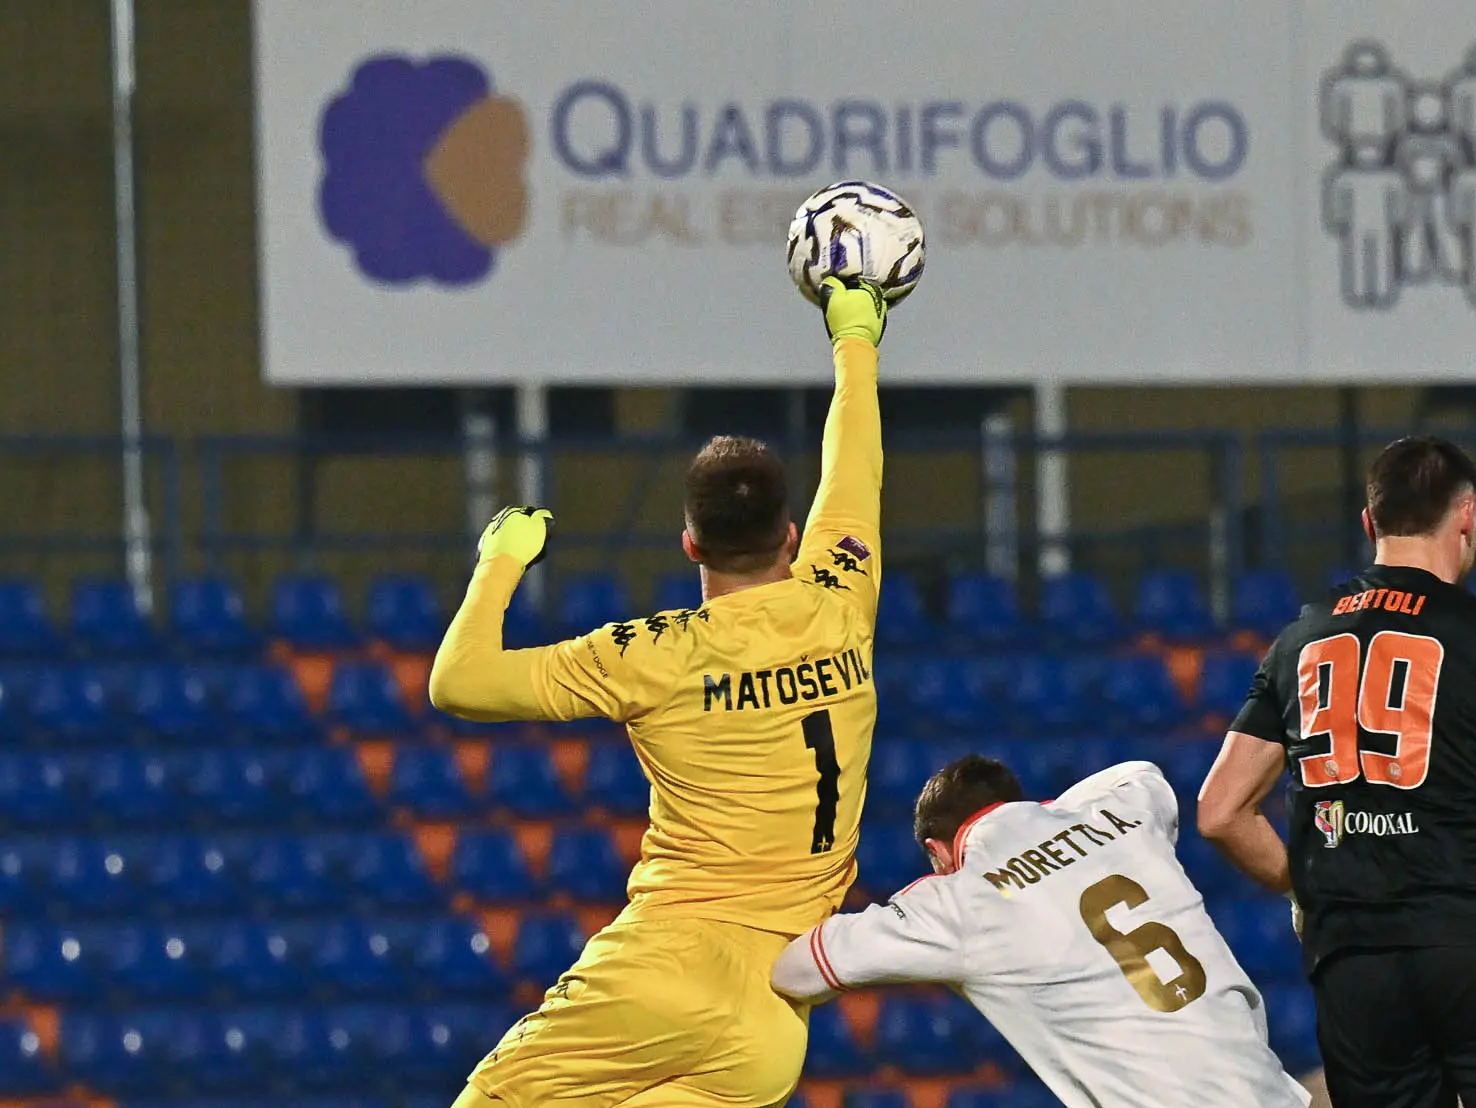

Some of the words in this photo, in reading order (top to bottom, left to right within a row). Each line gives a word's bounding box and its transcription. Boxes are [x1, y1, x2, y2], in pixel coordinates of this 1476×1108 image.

[562, 188, 702, 247] REAL
[935, 188, 1254, 248] SOLUTIONS
[1332, 588, 1427, 616] BERTOLI
[1297, 631, 1444, 790] 99
[801, 709, 841, 854] 1
[1079, 873, 1207, 1013] 6
